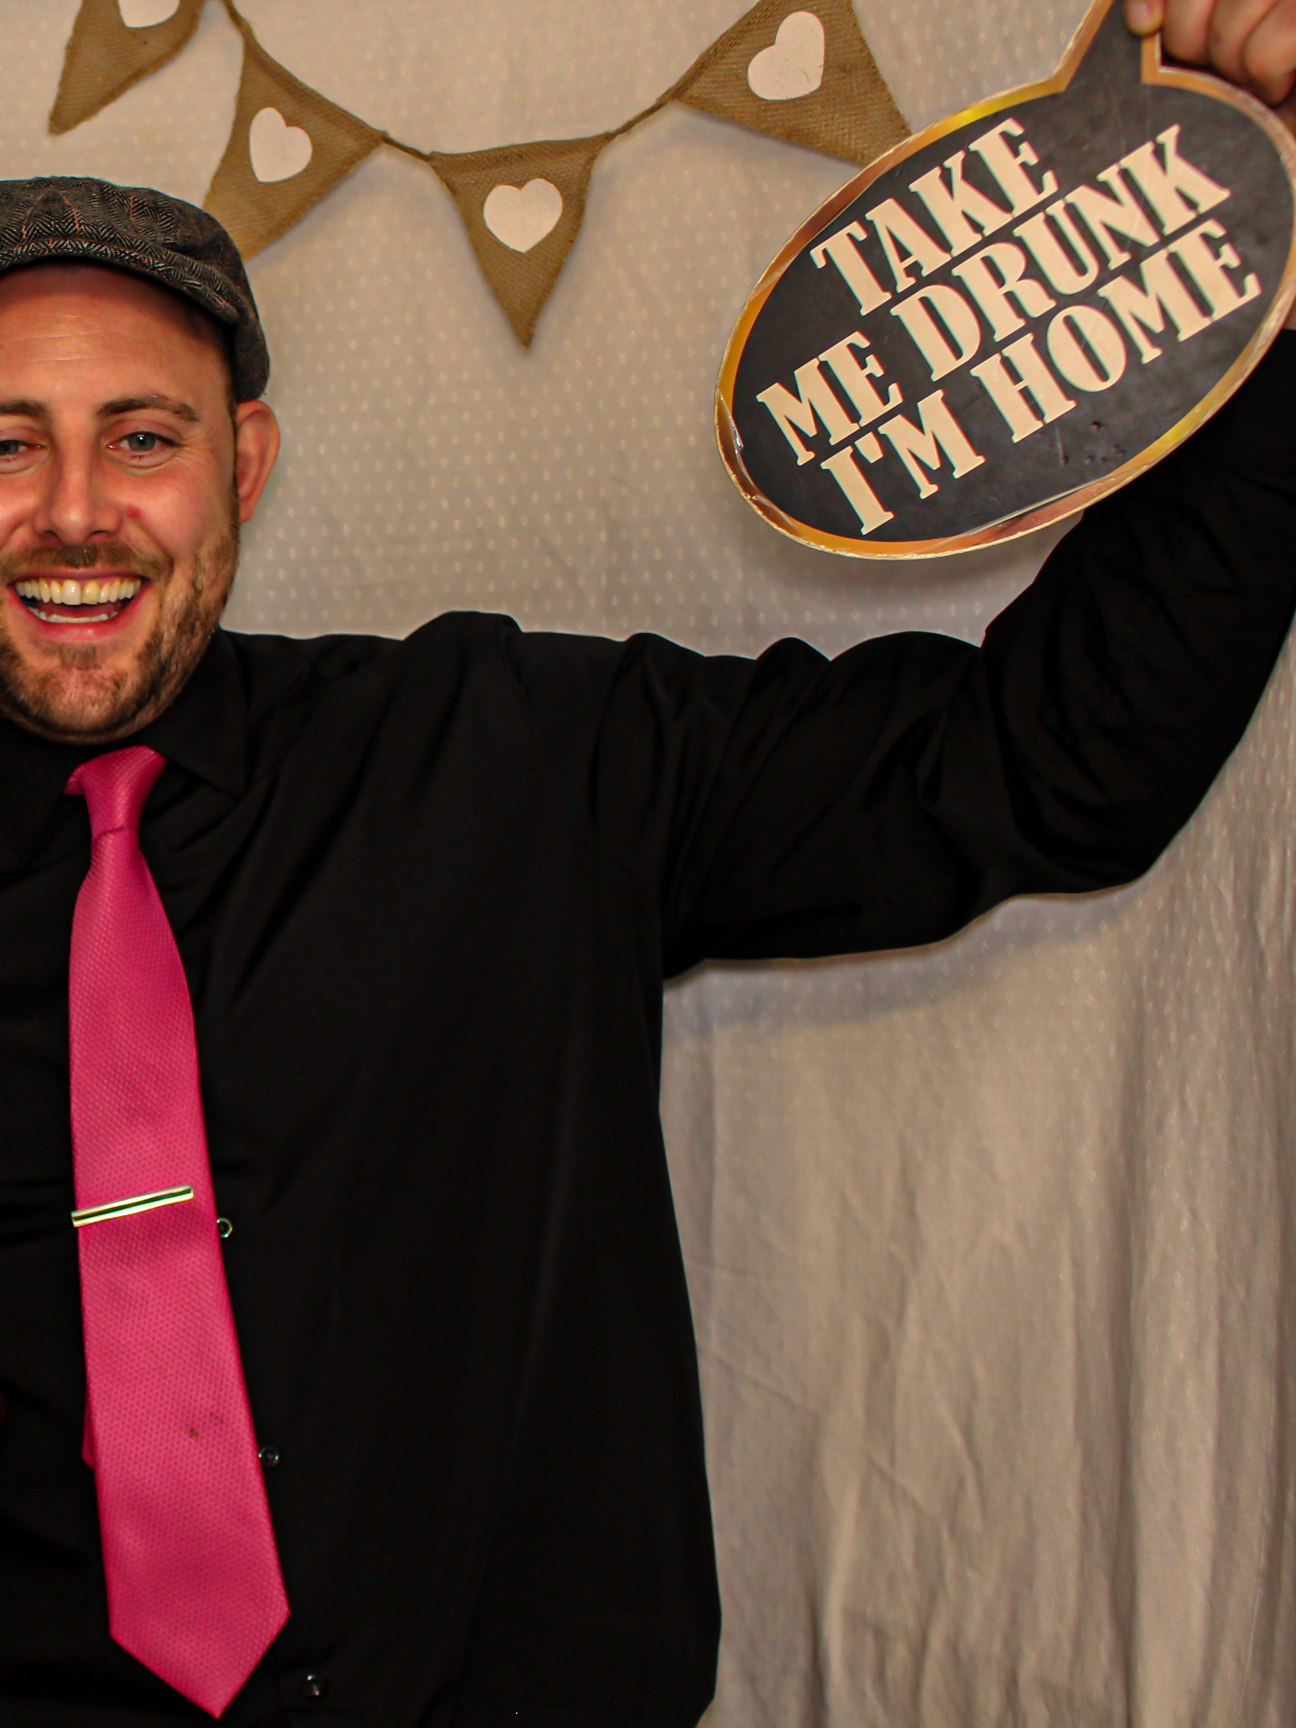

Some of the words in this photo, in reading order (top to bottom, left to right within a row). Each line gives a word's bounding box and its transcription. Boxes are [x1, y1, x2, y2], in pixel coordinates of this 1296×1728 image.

[756, 331, 903, 466] ME
[890, 124, 1230, 382] DRUNK
[809, 118, 1059, 317] TAKE
[820, 389, 986, 535] I'M
[970, 218, 1262, 443] HOME
